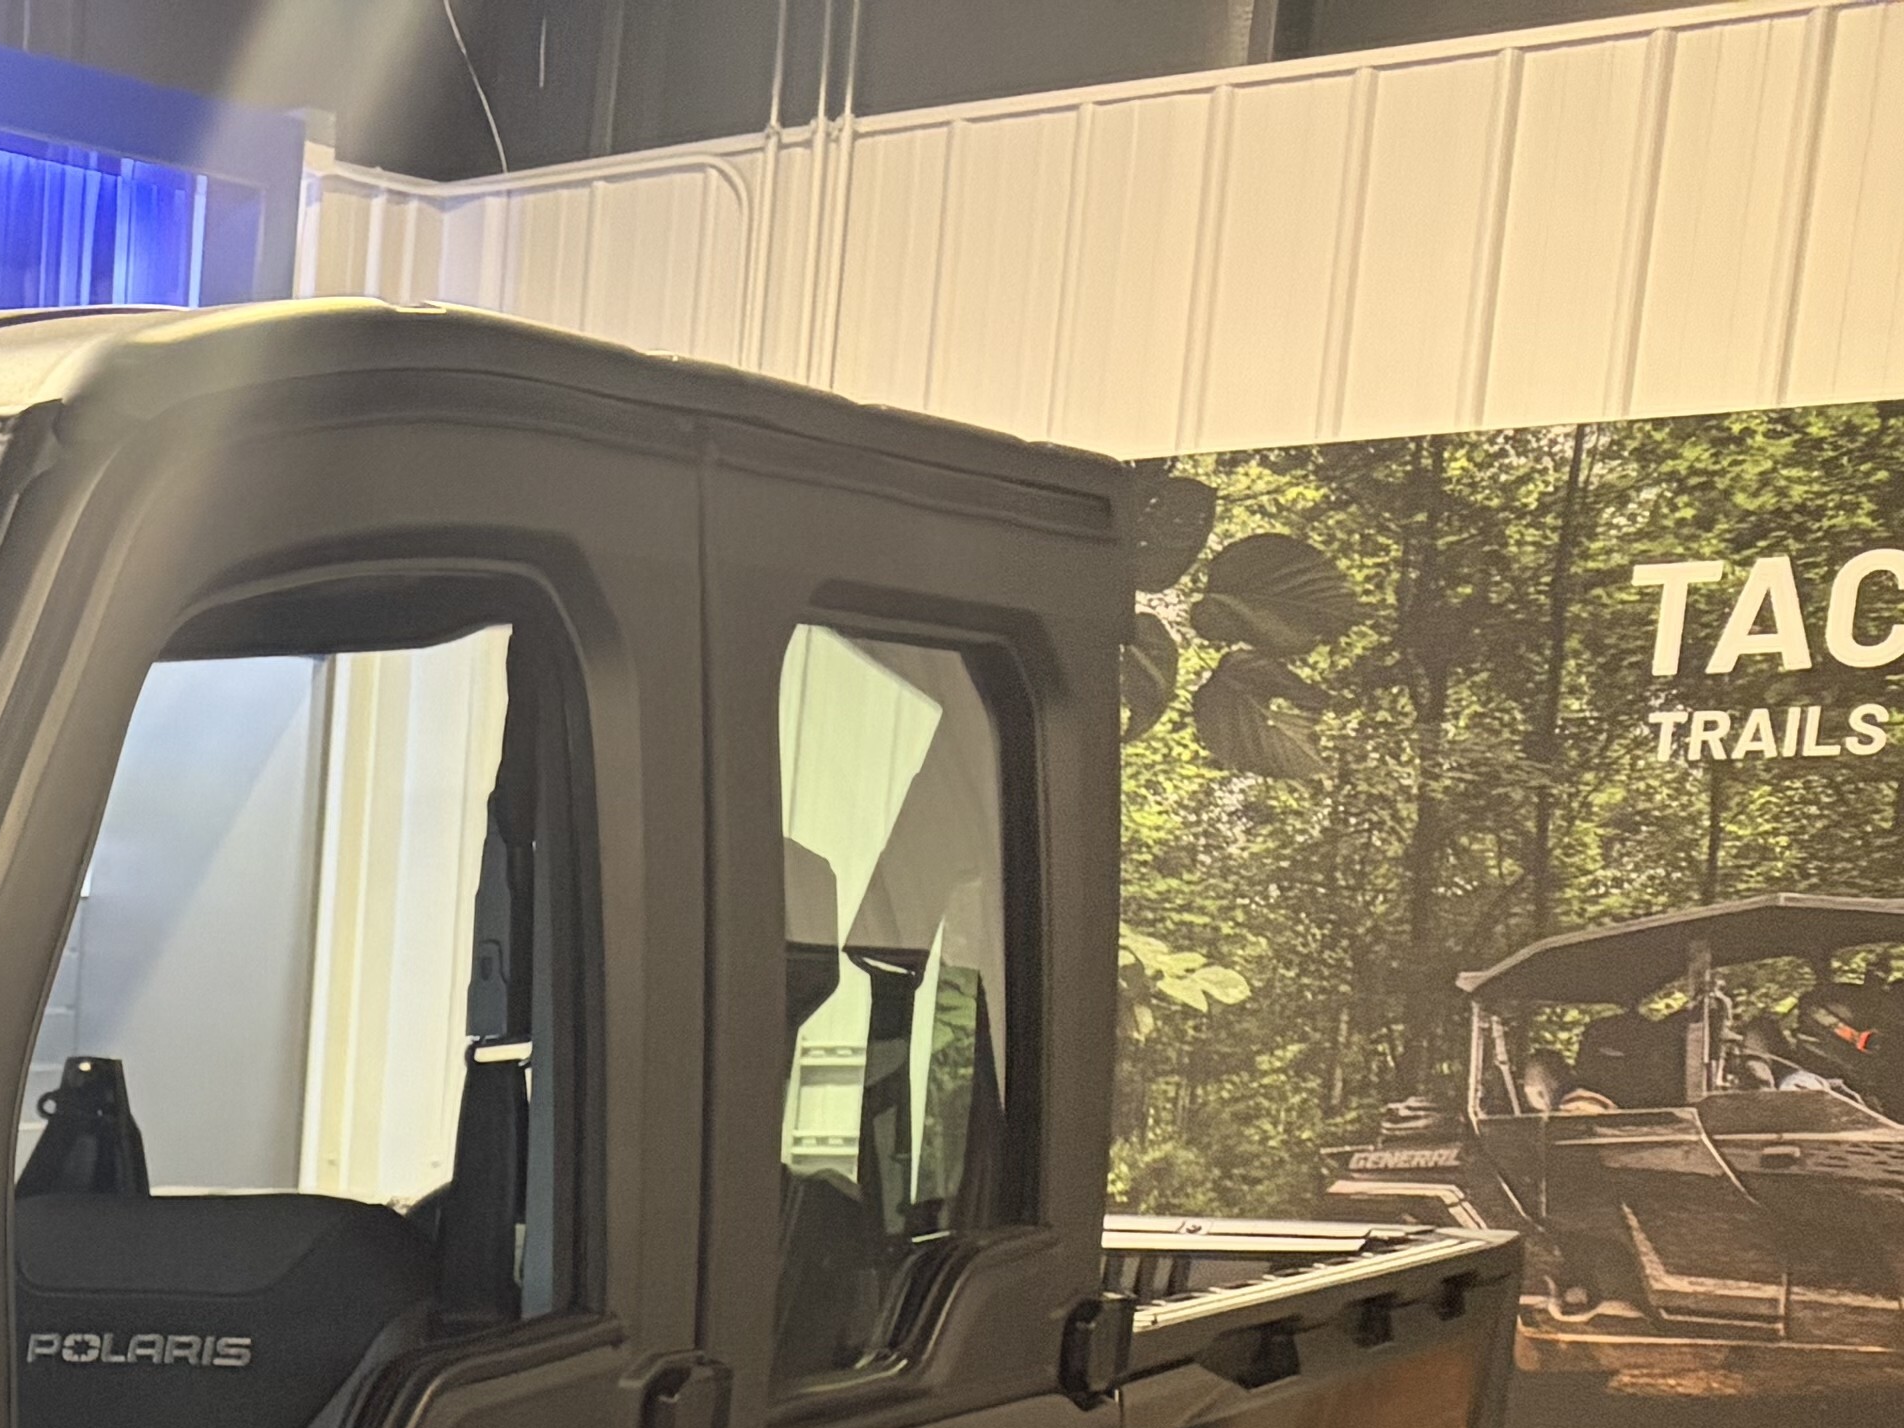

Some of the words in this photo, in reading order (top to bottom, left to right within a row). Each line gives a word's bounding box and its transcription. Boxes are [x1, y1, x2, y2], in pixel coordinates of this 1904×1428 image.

[1632, 548, 1904, 677] TAC
[1649, 703, 1891, 762] TRAILS
[1348, 1147, 1463, 1170] GENERAL
[26, 1331, 253, 1367] POLARIS
